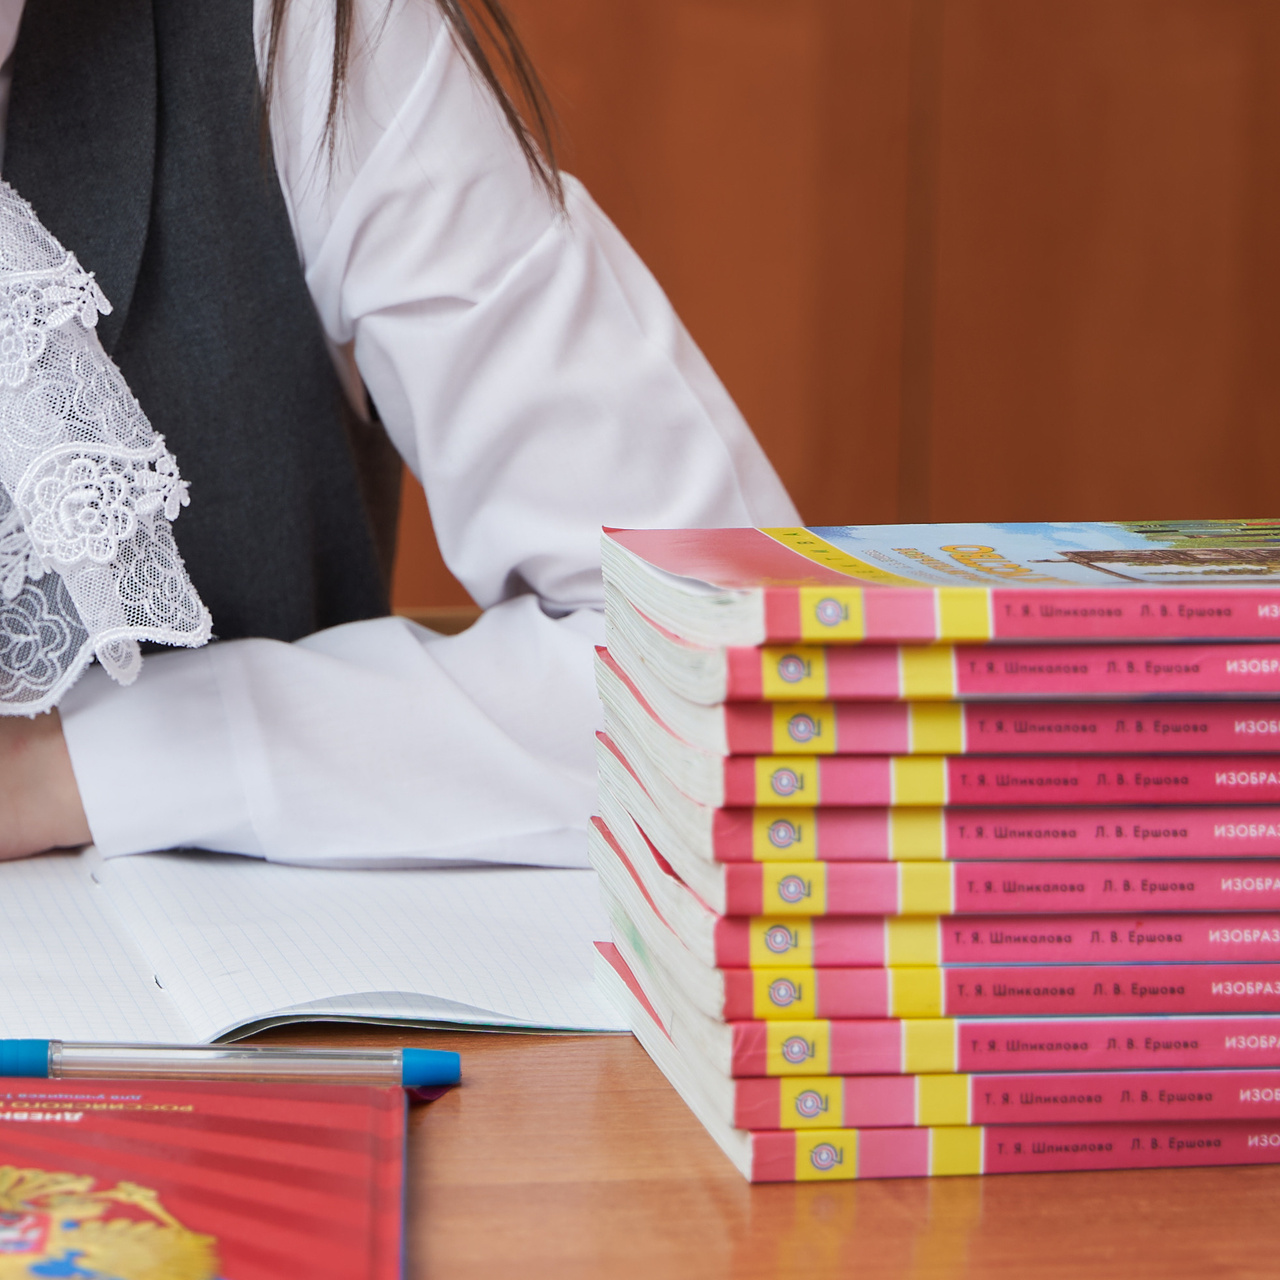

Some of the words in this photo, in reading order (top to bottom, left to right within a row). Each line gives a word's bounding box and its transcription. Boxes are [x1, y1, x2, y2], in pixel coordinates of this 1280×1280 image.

[1004, 605, 1016, 617] Т.
[1020, 605, 1034, 617] Я.
[1039, 605, 1124, 617] Шпикалова
[1140, 605, 1154, 617] Л.
[1160, 605, 1174, 617] В.
[1178, 605, 1234, 619] Ершова
[1258, 604, 1280, 618] ИЗ
[968, 663, 980, 674] Т.
[984, 663, 998, 674] Я.
[1003, 662, 1088, 674] Шпикалова
[1104, 662, 1118, 674] Л.
[1124, 662, 1138, 673] В.
[1142, 662, 1198, 675] Ершова
[1226, 660, 1280, 673] ИЗОБР
[978, 720, 990, 733] Т.
[994, 720, 1008, 733] Я.
[1013, 720, 1098, 733] Шпикалова
[1114, 720, 1128, 733] Л.
[1134, 720, 1148, 733] В.
[1152, 720, 1208, 735] Ершова
[1234, 720, 1280, 734] ИЗОБ
[960, 774, 972, 786] Т.
[976, 774, 990, 786] Я.
[995, 774, 1080, 786] Шпикалова
[1096, 774, 1110, 785] Л.
[1116, 774, 1130, 785] В.
[1134, 774, 1190, 787] Ершова
[1215, 772, 1280, 785] ИЗОБРА
[958, 826, 970, 839] Т.
[974, 826, 988, 839] Я.
[992, 826, 1078, 839] Шпикалова
[1093, 826, 1108, 838] Л.
[1113, 826, 1128, 838] В.
[1131, 826, 1187, 840] Ершова
[967, 881, 980, 893] Т.
[984, 881, 998, 893] Я.
[1002, 881, 1088, 893] Шпикалова
[1102, 880, 1117, 892] Л.
[1122, 880, 1137, 892] В.
[1140, 880, 1196, 894] Ершова
[954, 932, 966, 944] Т.
[970, 932, 984, 944] Я.
[989, 932, 1074, 944] Шпикалова
[1090, 931, 1104, 943] Л.
[1110, 931, 1124, 943] В.
[1128, 931, 1184, 945] Ершова
[957, 984, 970, 997] Т.
[974, 984, 988, 996] Я.
[992, 984, 1078, 996] Шпикалова
[1092, 984, 1107, 995] Л.
[1112, 983, 1127, 995] В.
[1130, 983, 1186, 997] Ершова
[970, 1040, 982, 1052] Т.
[986, 1040, 1000, 1052] Я.
[1005, 1039, 1090, 1051] Шпикалова
[1106, 1039, 1120, 1050] Л.
[1126, 1038, 1140, 1050] В.
[1144, 1038, 1200, 1051] Ершова
[984, 1093, 996, 1105] Т.
[1000, 1093, 1014, 1105] Я.
[1019, 1092, 1104, 1104] Шпикалова
[1120, 1091, 1134, 1103] Л.
[1140, 1091, 1154, 1102] В.
[1158, 1090, 1214, 1104] Ершова
[11, 1101, 193, 1112] РОССИЙСКОГО
[997, 1143, 1009, 1155] Т.
[1013, 1143, 1027, 1155] Я.
[1031, 1140, 1116, 1154] Шпикалова
[1130, 1140, 1145, 1151] Л.
[1150, 1139, 1164, 1150] В.
[1168, 1138, 1223, 1151] Ершова
